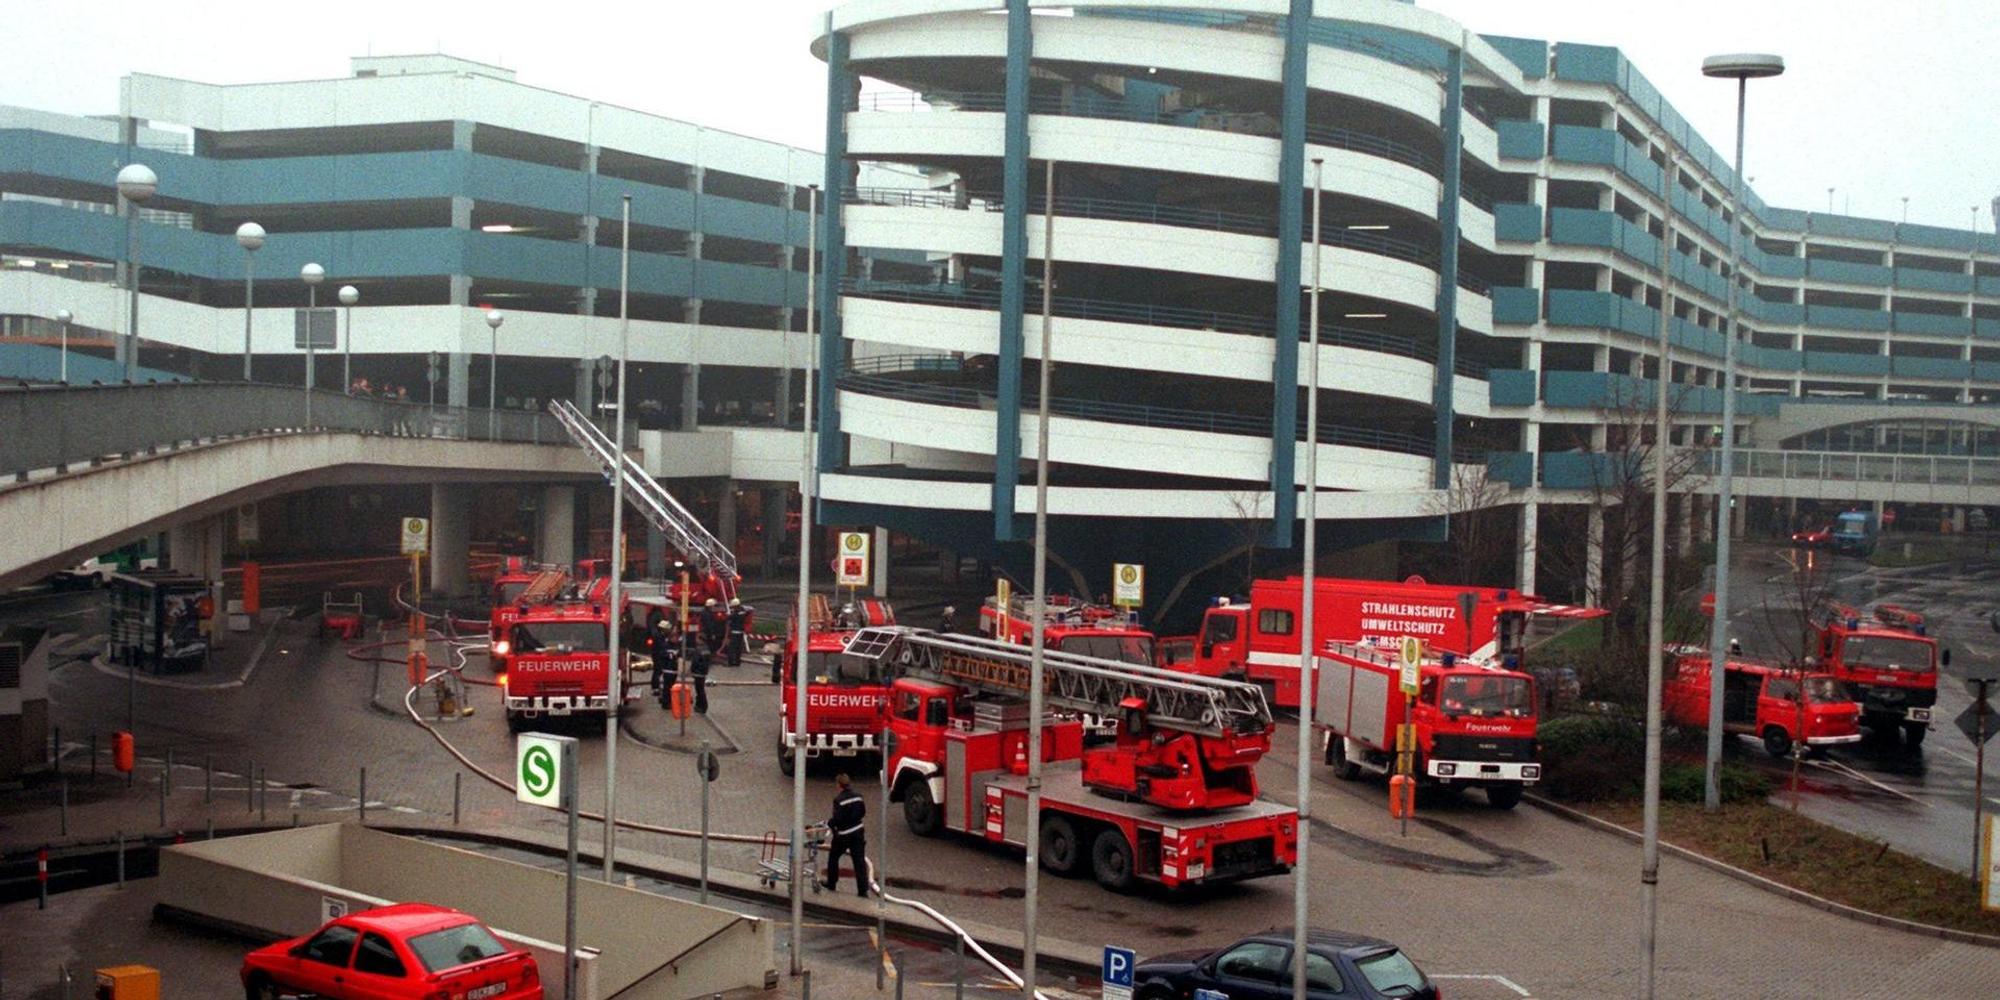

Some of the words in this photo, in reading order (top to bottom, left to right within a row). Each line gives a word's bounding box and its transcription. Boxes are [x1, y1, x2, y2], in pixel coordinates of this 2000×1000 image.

[1361, 602, 1456, 619] STRAHLENSCHUTZ
[1361, 618, 1445, 635] UMWELTSCHUTZ
[517, 660, 601, 672] FEUERWEHR
[1465, 722, 1512, 732] Feuerwehr
[528, 751, 549, 792] S
[1110, 953, 1127, 980] P
